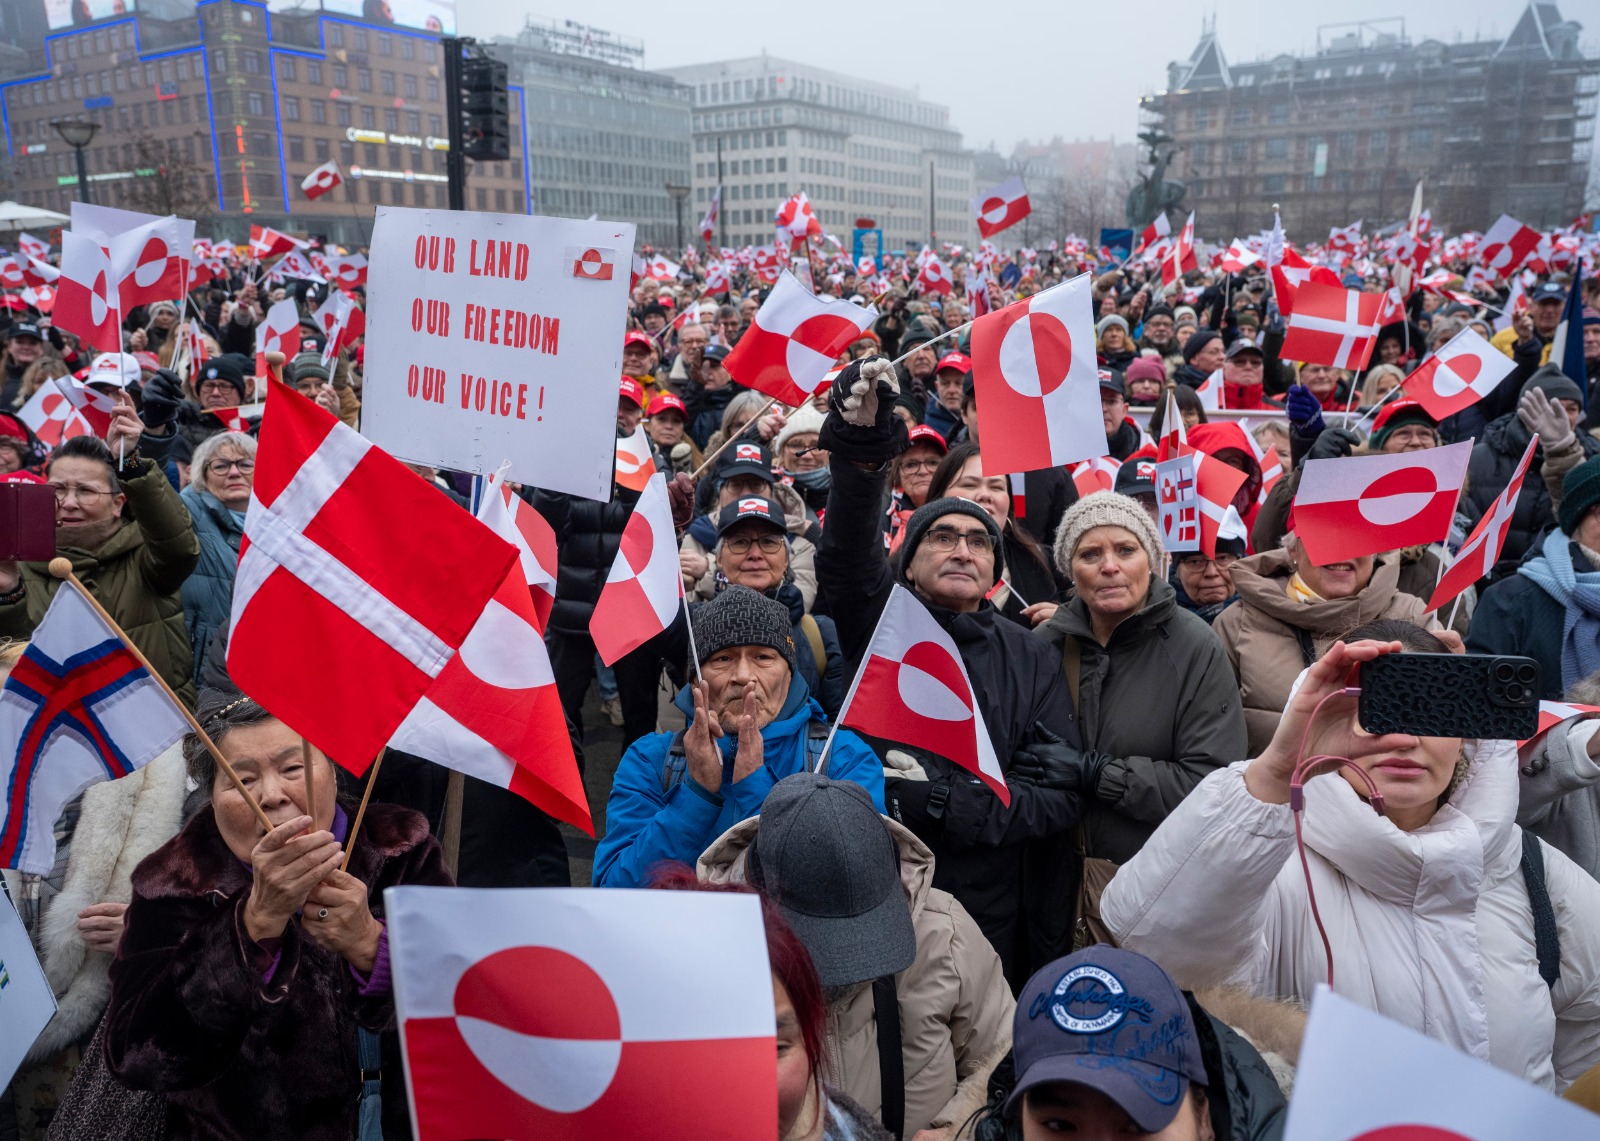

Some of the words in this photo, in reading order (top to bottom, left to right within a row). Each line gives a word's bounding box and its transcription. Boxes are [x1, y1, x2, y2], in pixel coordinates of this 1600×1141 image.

[414, 234, 456, 273] OUR
[469, 239, 530, 282] LAND
[411, 297, 450, 337] OUR
[464, 303, 561, 356] FREEDOM
[407, 364, 446, 404] OUR
